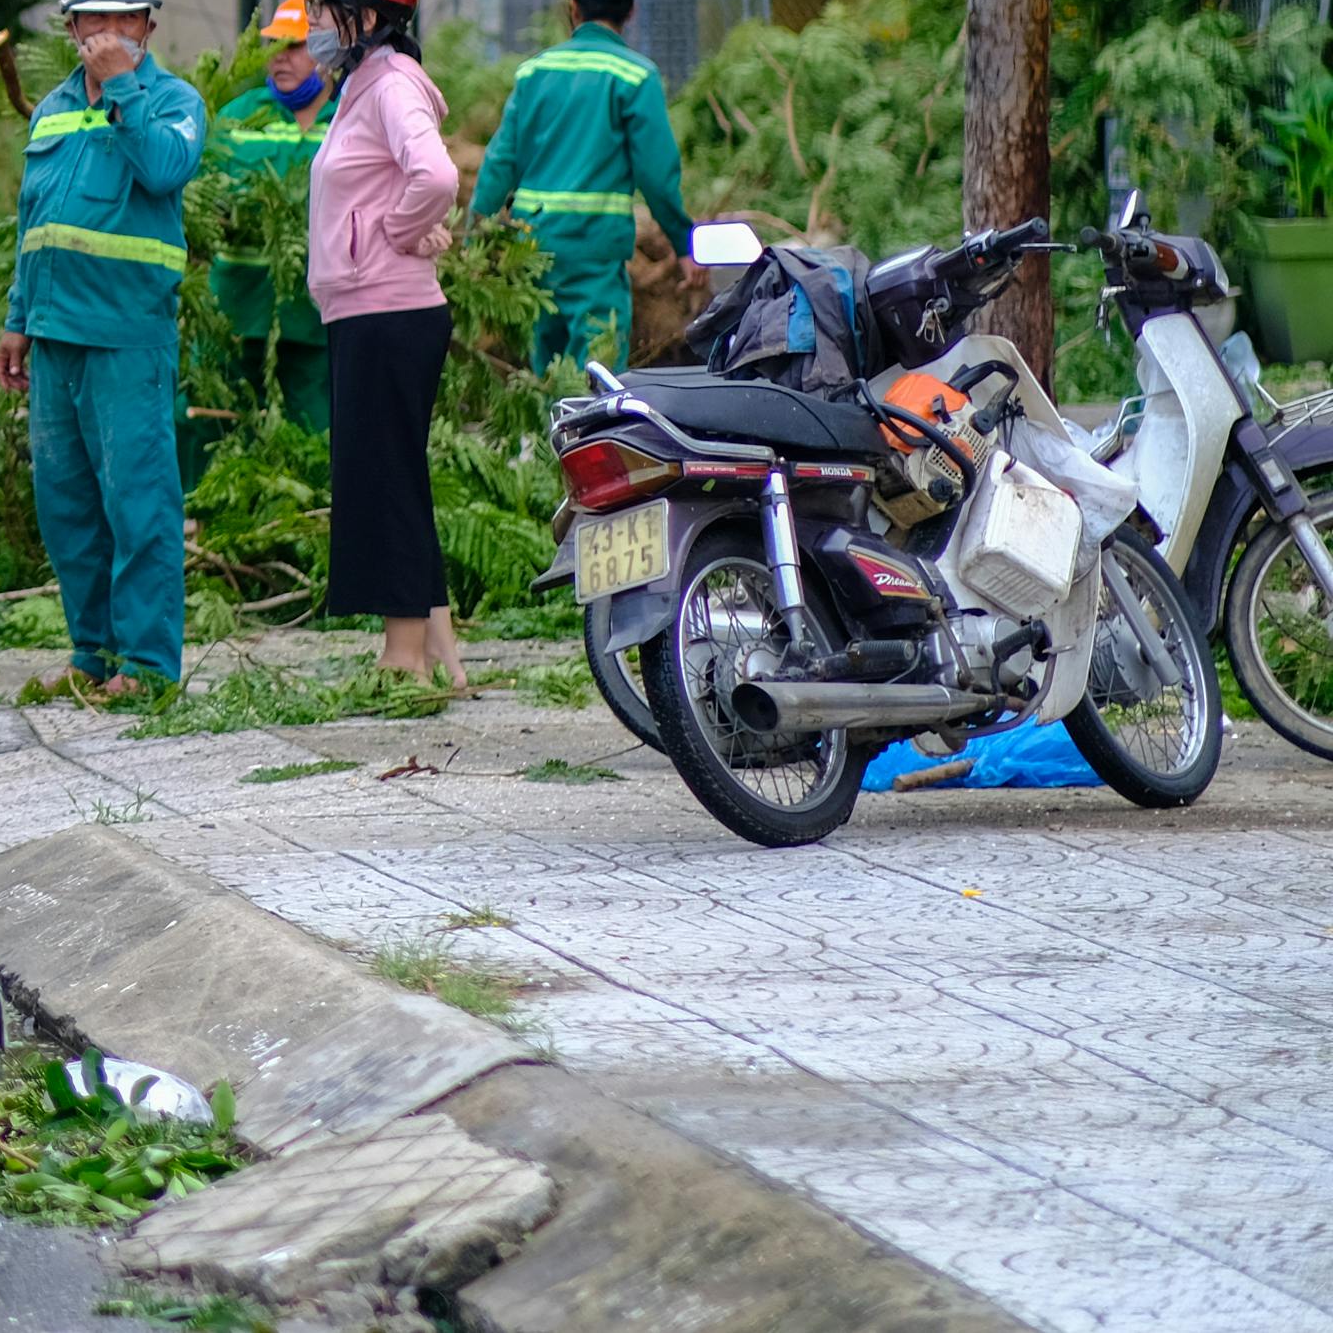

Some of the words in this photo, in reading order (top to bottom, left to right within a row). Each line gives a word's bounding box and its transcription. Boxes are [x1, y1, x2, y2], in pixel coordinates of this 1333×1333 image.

[820, 466, 853, 477] HONDA
[589, 544, 653, 593] 6875
[874, 572, 915, 588] Dream
